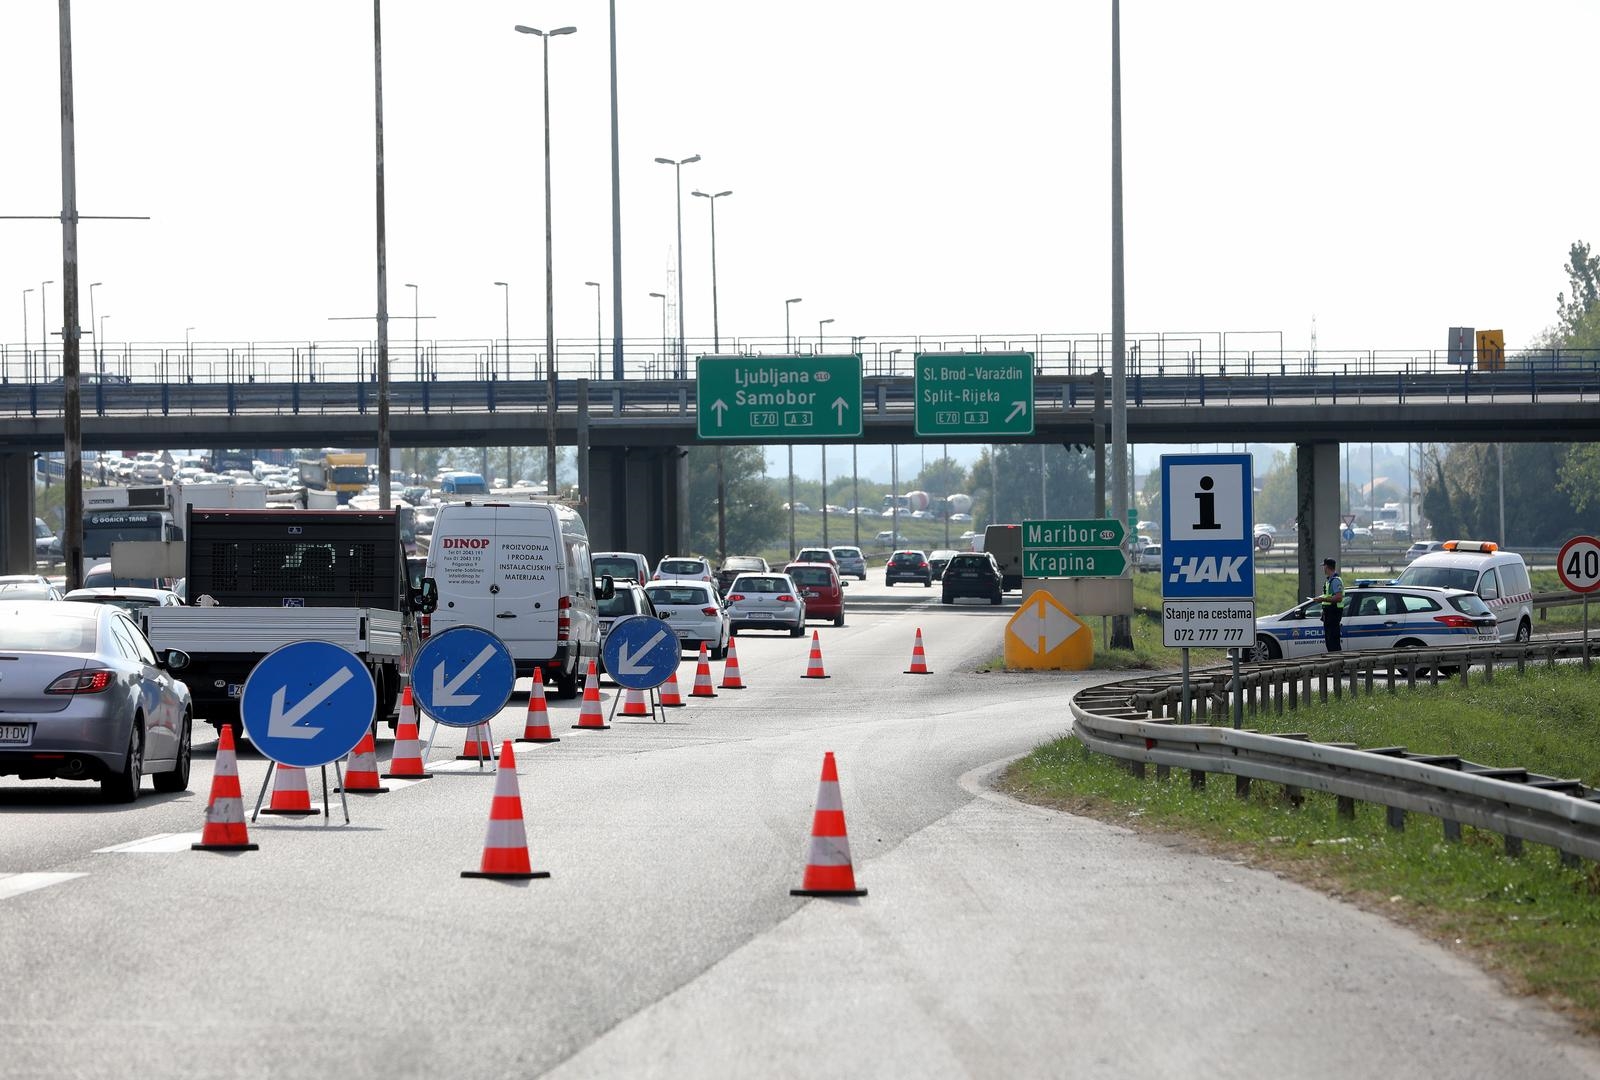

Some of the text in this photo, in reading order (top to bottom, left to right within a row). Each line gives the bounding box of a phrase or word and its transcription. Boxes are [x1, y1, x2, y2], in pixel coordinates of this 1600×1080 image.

[735, 368, 809, 387] Ljubljana
[923, 367, 938, 381] Sl.
[735, 390, 816, 406] Samobor
[924, 389, 1000, 406] Split-Rijeka
[1029, 525, 1097, 543] Maribor
[443, 538, 490, 549] DINOP
[499, 563, 551, 571] INSTALACIJSKIH
[1029, 552, 1095, 575] Krapina
[1168, 555, 1248, 583] HAK
[1567, 550, 1599, 579] 40
[1165, 607, 1252, 622] Stanje na cestama
[1174, 629, 1244, 641] 072 777 777
